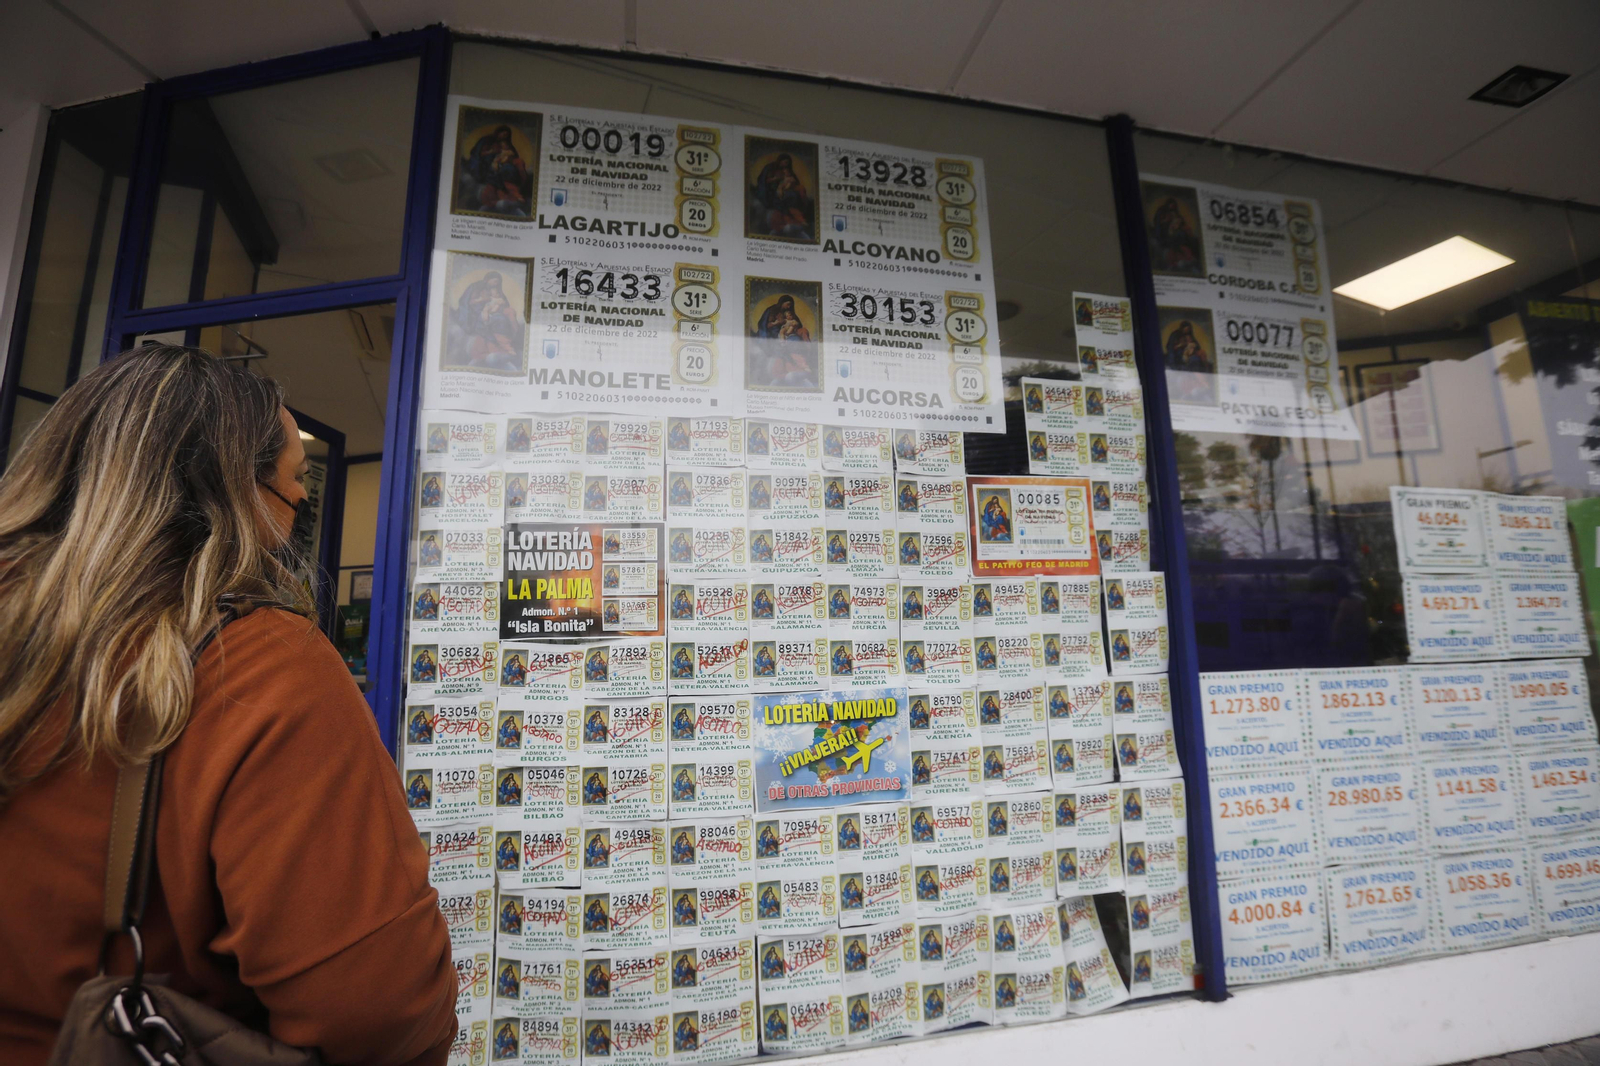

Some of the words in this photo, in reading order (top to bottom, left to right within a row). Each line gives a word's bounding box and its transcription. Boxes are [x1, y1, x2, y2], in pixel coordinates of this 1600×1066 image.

[560, 125, 665, 157] 00019
[550, 153, 603, 167] LOTERÍA
[607, 159, 669, 172] NACIONAL
[571, 167, 589, 176] DE
[592, 169, 648, 181] NAVIDAD
[839, 156, 926, 187] 13928
[569, 176, 579, 184] de
[582, 178, 625, 188] diciembre
[628, 181, 639, 189] de
[828, 182, 875, 195] LOTERÍA
[878, 188, 932, 201] NACIONAL
[848, 195, 862, 203] DE
[865, 196, 915, 209] NAVIDAD
[688, 208, 706, 221] 20
[1210, 200, 1280, 228] 06854
[539, 214, 679, 238] LAGARTIJO
[823, 239, 940, 263] ALCOYANO
[683, 271, 710, 279] 102/22
[556, 268, 660, 300] 16433
[1208, 274, 1276, 291] CORDOBA
[541, 302, 596, 312] LOTERÍA
[601, 306, 665, 316] NACIONAL
[841, 293, 935, 325] 30153
[563, 314, 583, 322] DE
[585, 316, 644, 327] NAVIDAD
[575, 326, 619, 336] diciembre
[637, 330, 657, 338] 2022
[832, 324, 882, 337] LOTERÍA
[885, 328, 940, 340] NACIONAL
[1227, 320, 1294, 348] 00077
[853, 336, 868, 345] DE
[871, 338, 923, 349] NAVIDAD
[686, 356, 704, 369] 20
[529, 368, 671, 391] MANOLETE
[962, 377, 977, 389] 20
[833, 387, 943, 409] AUCORSA
[1221, 402, 1279, 418] PATITO
[536, 421, 570, 431] 85537
[696, 421, 728, 430] 17193
[776, 477, 807, 487] 90975
[1113, 483, 1137, 492] 68124
[1018, 494, 1060, 505] 00085
[446, 533, 483, 542] 07033
[508, 527, 593, 550] LOTERÍA
[850, 533, 880, 543] 02975
[923, 536, 952, 544] 72596
[508, 552, 593, 571] NAVIDAD
[445, 586, 483, 596] 44062
[508, 579, 531, 600] LA
[537, 578, 593, 599] PALMA
[854, 587, 885, 597] 74973
[995, 585, 1024, 594] 49452
[438, 596, 492, 612] AGOTADO
[522, 608, 555, 616] Admon.
[999, 638, 1028, 647] 08220
[441, 647, 479, 657] 30682
[1208, 685, 1237, 695] GRAN
[1240, 683, 1284, 693] PREMIO
[1319, 681, 1344, 690] GRAN
[1347, 679, 1388, 688] PREMIO
[934, 695, 962, 706] 86790
[1285, 700, 1292, 710] €
[1391, 696, 1397, 705] €
[439, 707, 477, 718] 53054
[700, 705, 735, 715] 09570
[764, 699, 829, 725] LOTERÍA
[833, 698, 896, 720] NAVIDAD
[528, 714, 563, 725] 10379
[523, 725, 562, 743] AGOTADO
[1318, 737, 1371, 749] VENDIDO
[779, 729, 859, 777] ¡¡VIAJERA!!
[437, 770, 475, 782] 11070
[528, 769, 564, 780] 05046
[1332, 776, 1360, 787] GRAN
[1362, 773, 1401, 784] PREMIO
[769, 786, 785, 800] DE
[788, 785, 828, 798] OTRAS
[832, 777, 901, 796] PROVINCIAS
[1218, 786, 1246, 798] GRAN
[1250, 782, 1295, 794] PREMIO
[1296, 800, 1304, 810] €
[938, 806, 969, 817] 69577
[865, 813, 897, 824] 58171
[700, 826, 735, 838] 88046
[1328, 834, 1384, 847] VENDIDO
[926, 844, 983, 854] VALLADOLID
[863, 852, 899, 861] MURCIA
[784, 882, 818, 892] 05483
[1229, 890, 1257, 904] GRAN
[1261, 885, 1307, 899] PREMIO
[1309, 902, 1316, 914] €
[700, 929, 736, 937] CEUTA
[524, 964, 561, 975] 71761
[522, 1021, 559, 1032] 84894
